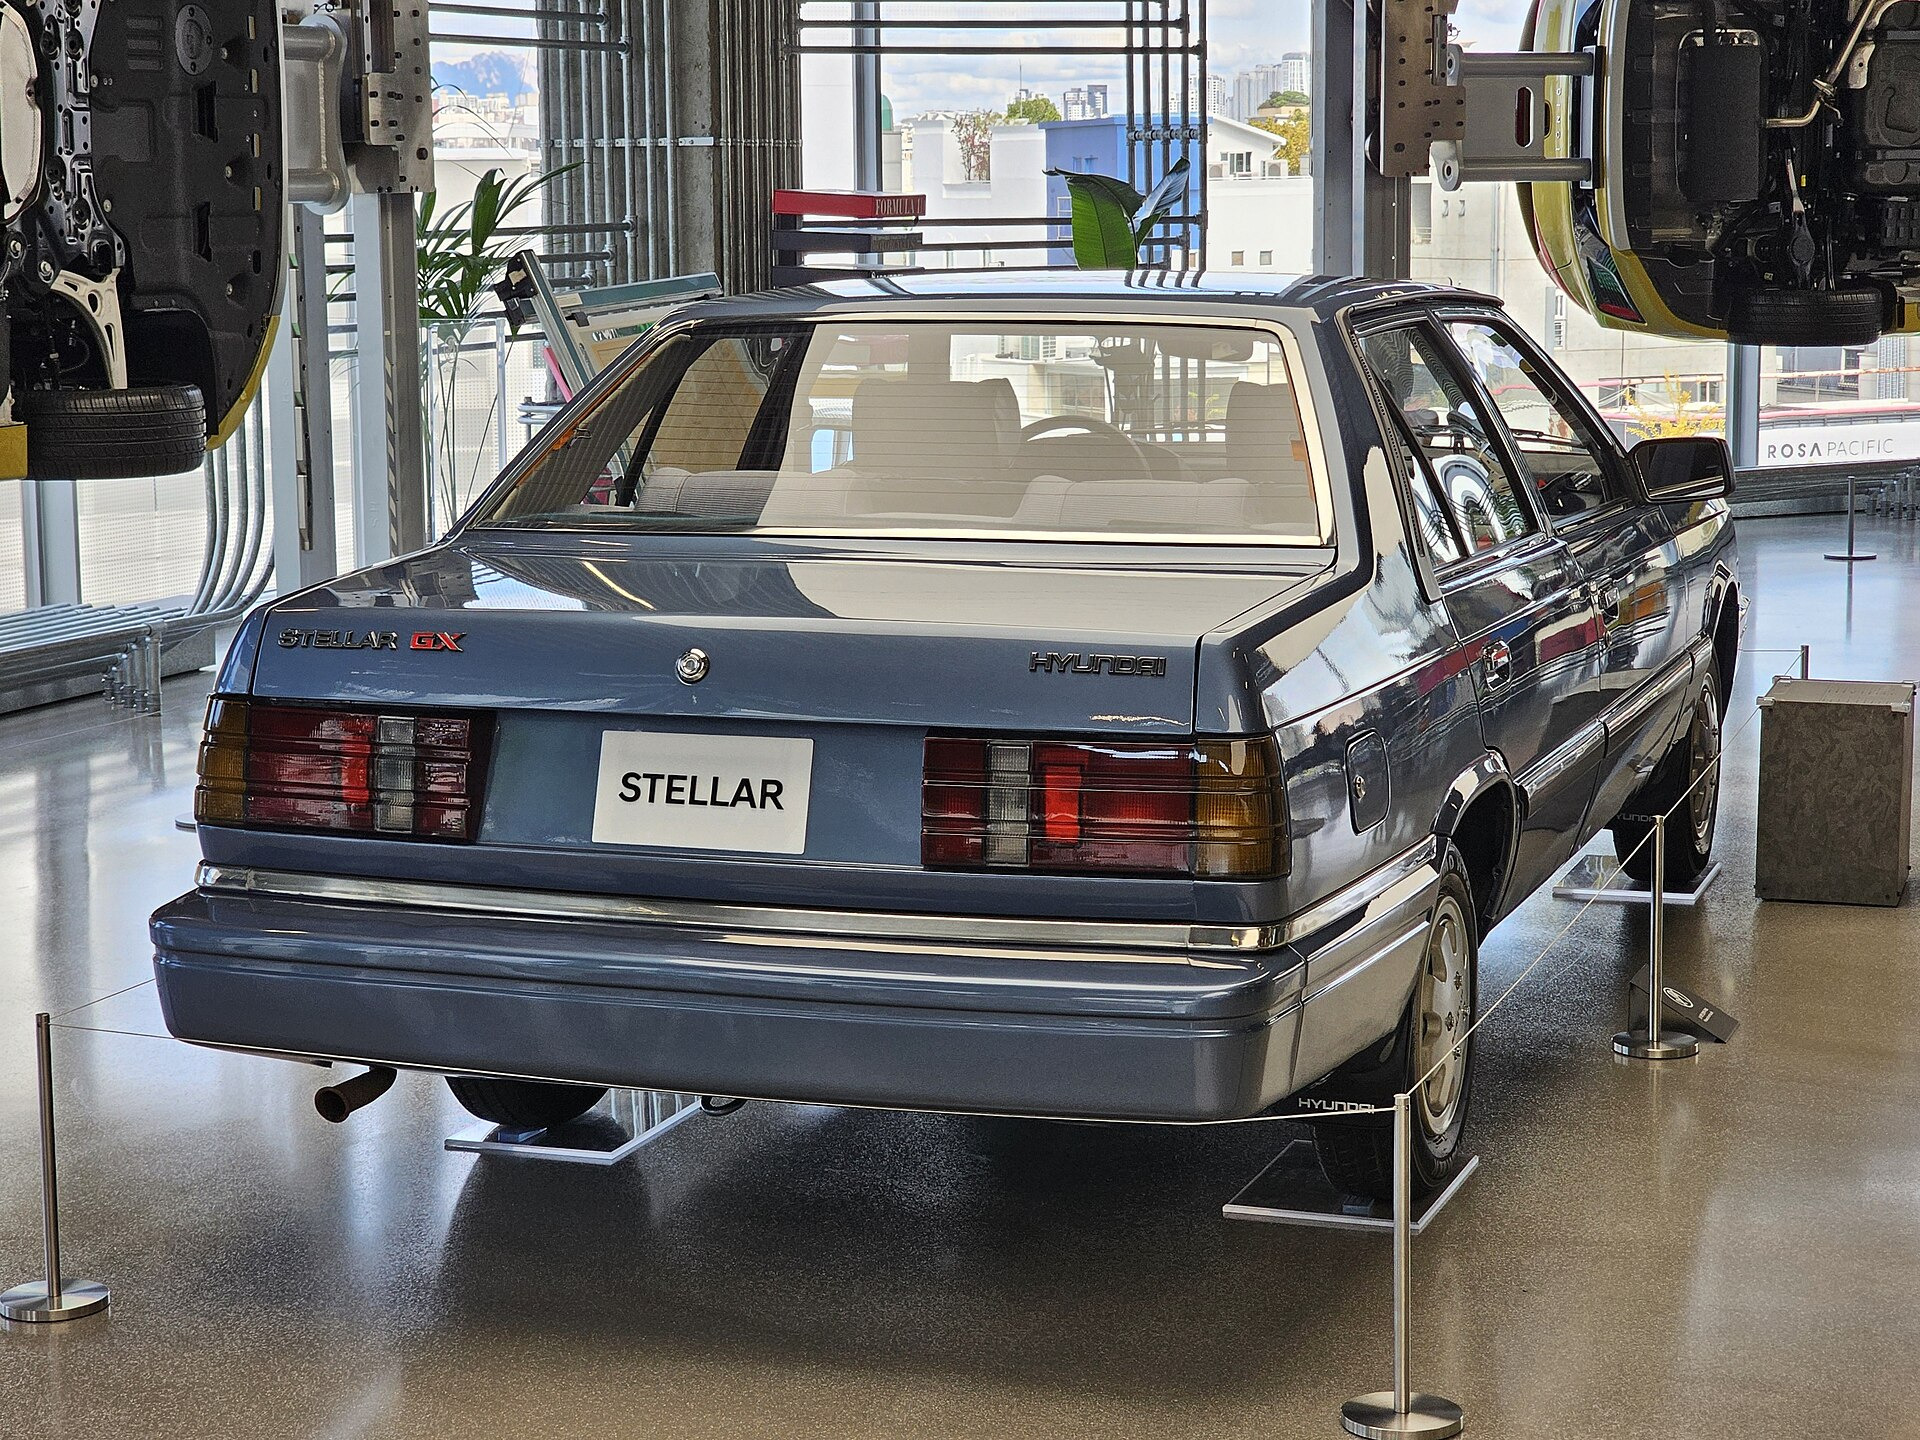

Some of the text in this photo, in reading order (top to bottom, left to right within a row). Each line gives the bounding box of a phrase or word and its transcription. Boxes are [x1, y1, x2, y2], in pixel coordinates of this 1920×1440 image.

[875, 198, 914, 215] FORMULA
[1767, 438, 1894, 459] ROSA PACIFIC
[277, 628, 467, 652] STELLAR GX
[1029, 651, 1166, 676] HYUNDAI
[618, 771, 785, 811] STELLAR
[1298, 1097, 1375, 1115] HYUNDAI
